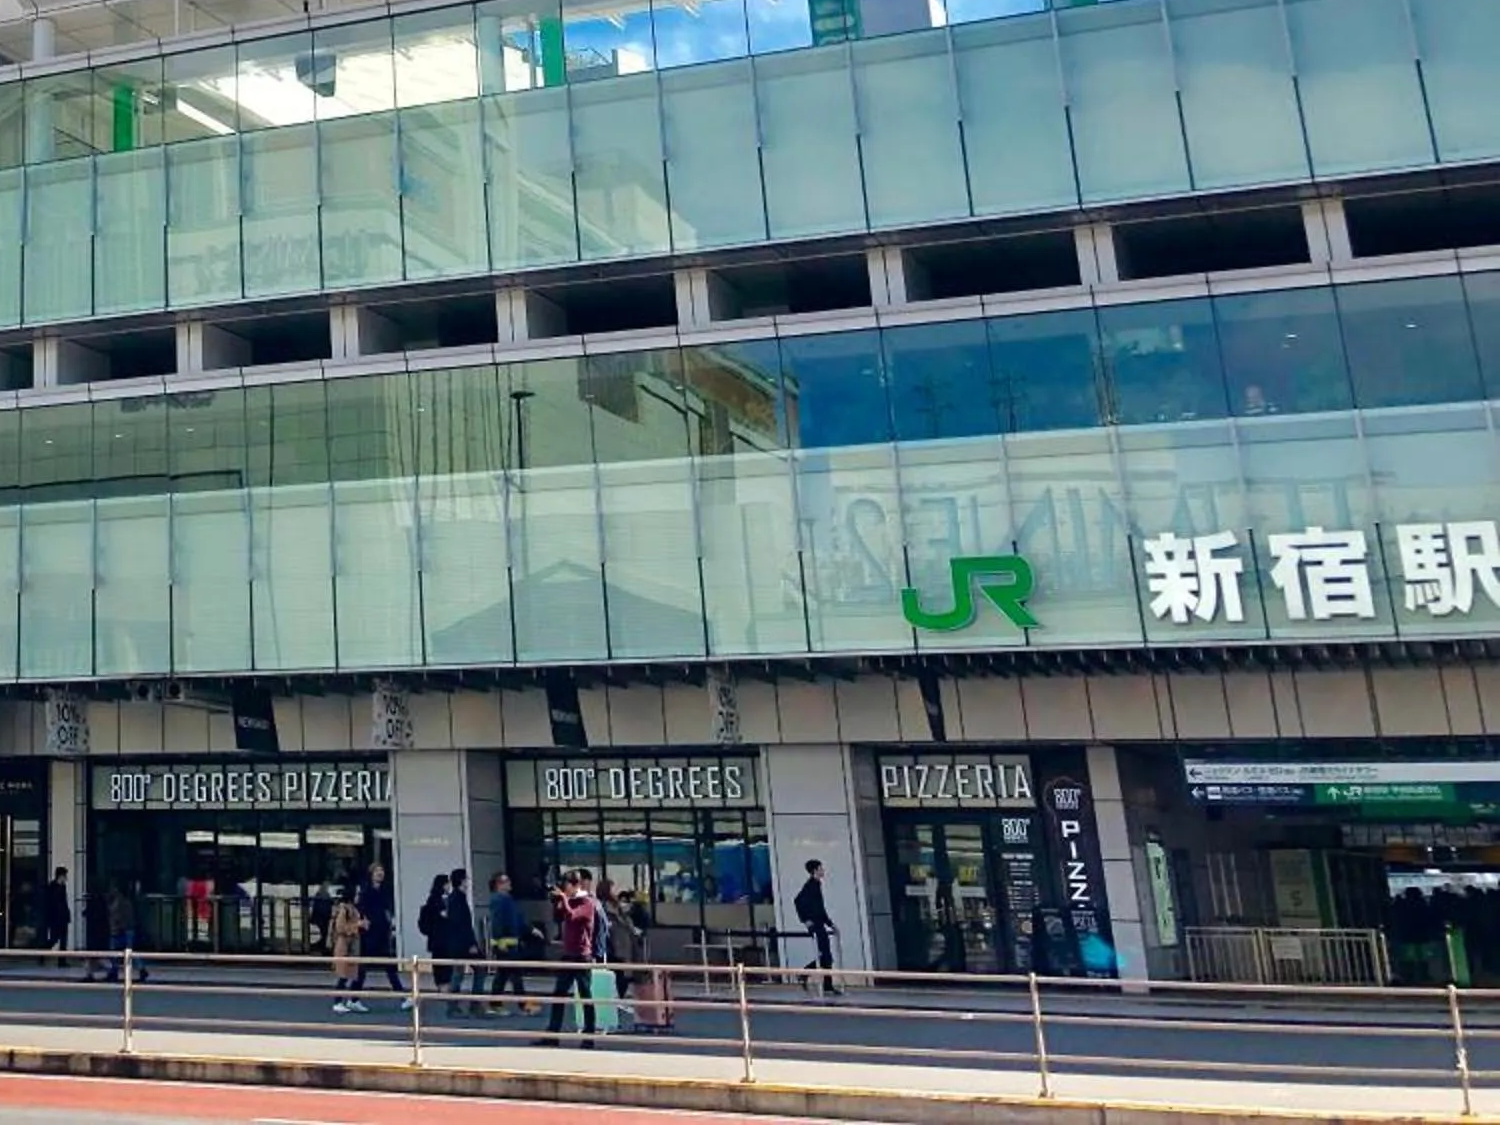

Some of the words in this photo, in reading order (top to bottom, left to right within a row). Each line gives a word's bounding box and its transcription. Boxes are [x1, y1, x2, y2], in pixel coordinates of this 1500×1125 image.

[901, 555, 1041, 631] JR
[1143, 520, 1500, 625] 新宿駅
[163, 772, 272, 802] DEGREES
[609, 765, 742, 799] DEGREES
[880, 764, 1033, 799] PIZZERIA
[1061, 820, 1091, 908] PIZZ
